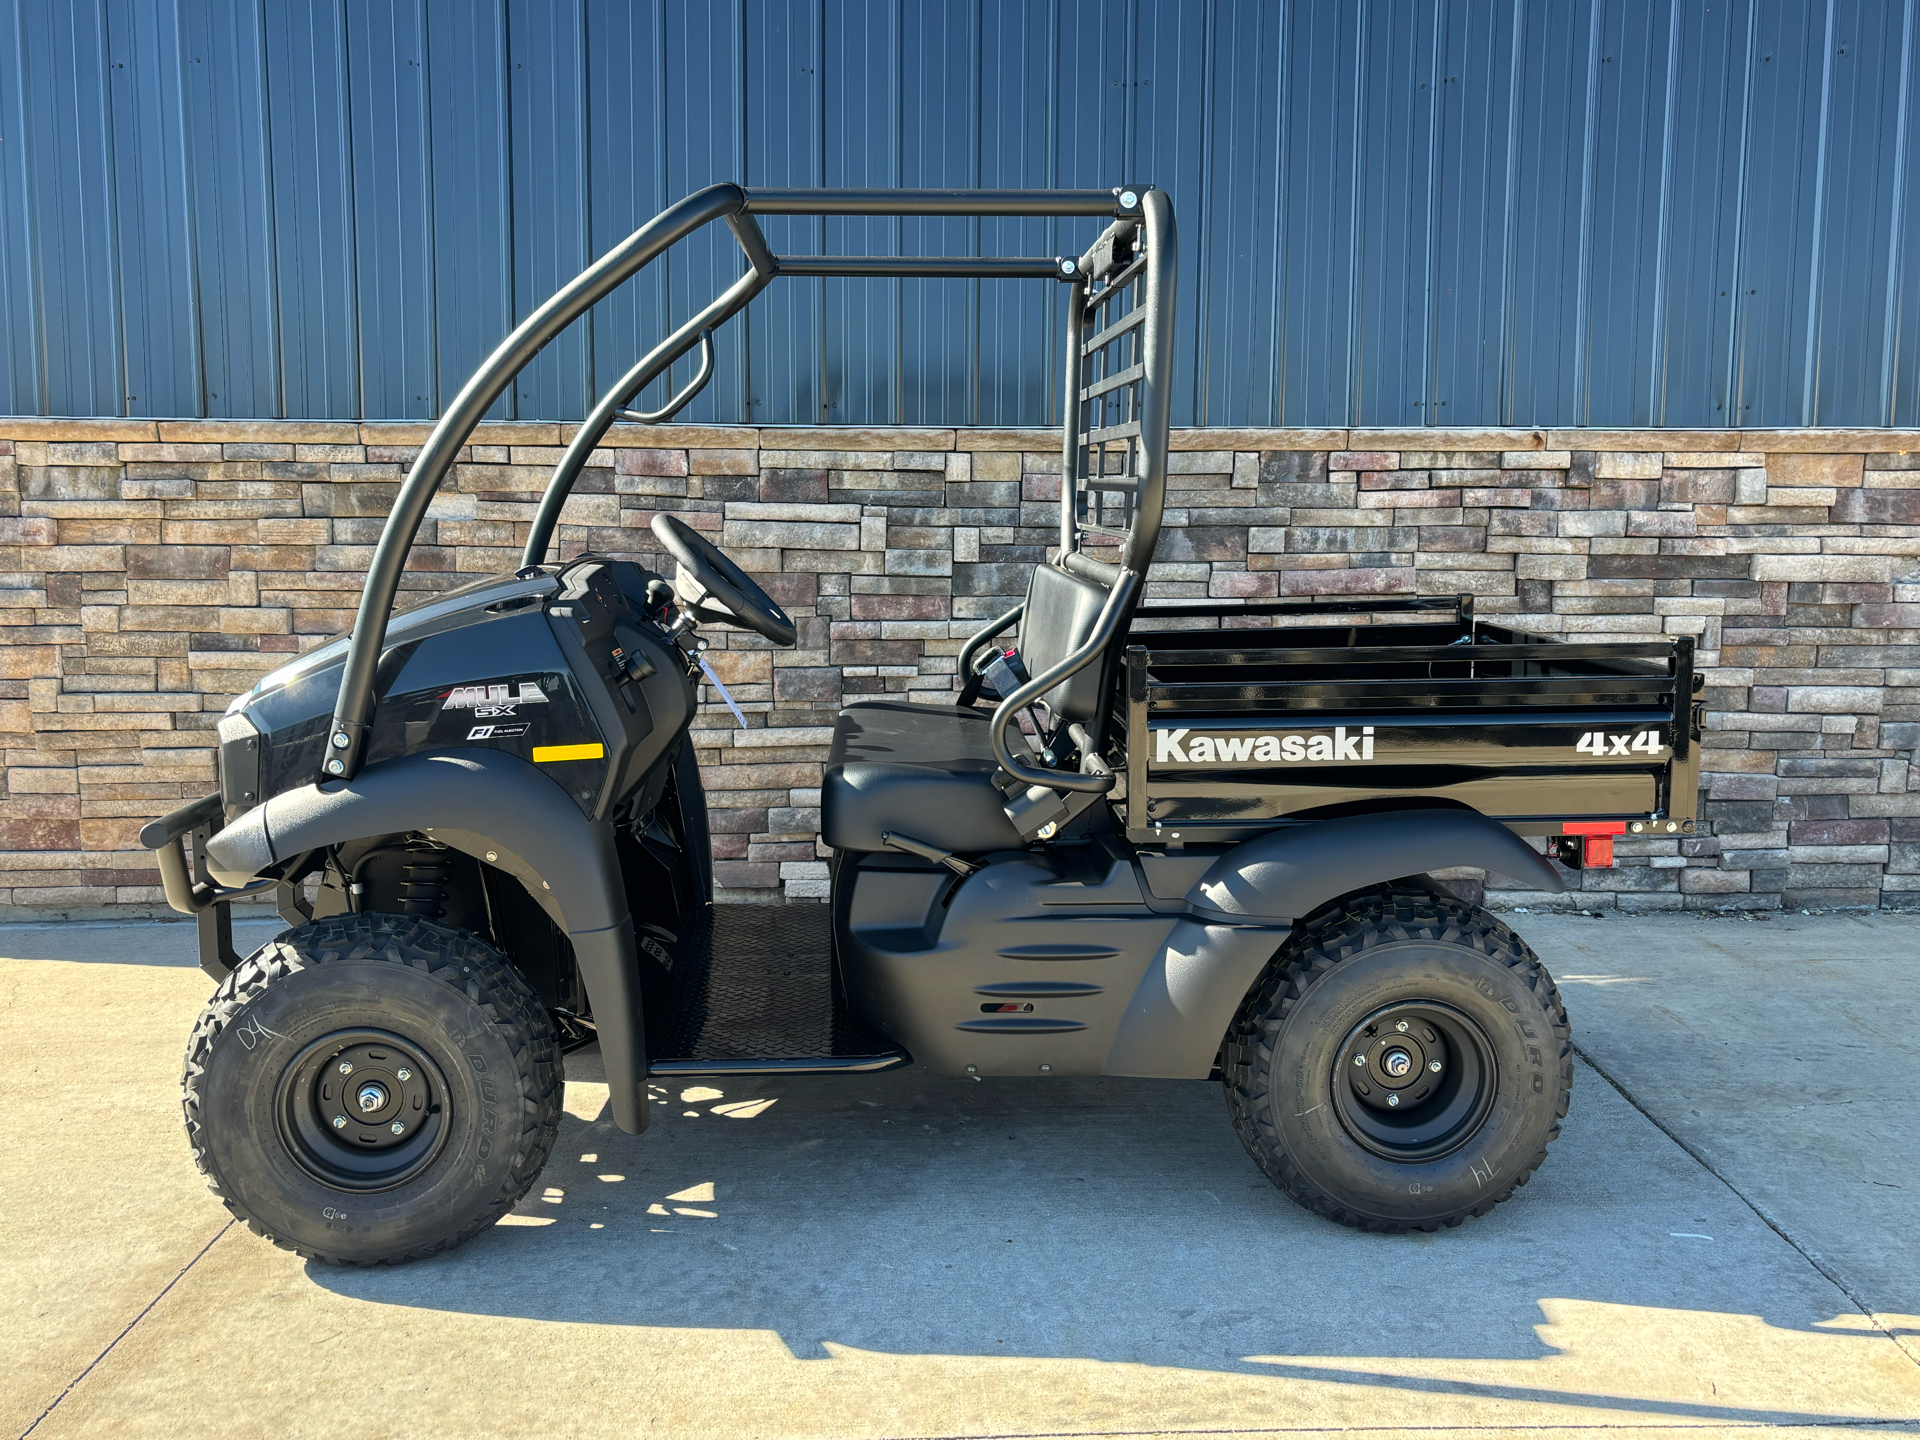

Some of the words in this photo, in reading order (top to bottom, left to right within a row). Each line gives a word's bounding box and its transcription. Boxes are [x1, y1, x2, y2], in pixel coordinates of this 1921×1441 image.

[441, 682, 549, 710] MULE
[474, 704, 517, 718] SX
[471, 727, 491, 737] FI
[1155, 726, 1375, 763] Kawasaki
[1576, 730, 1664, 756] 4x4
[1499, 995, 1545, 1095] DURO
[467, 1053, 494, 1162] DURO
